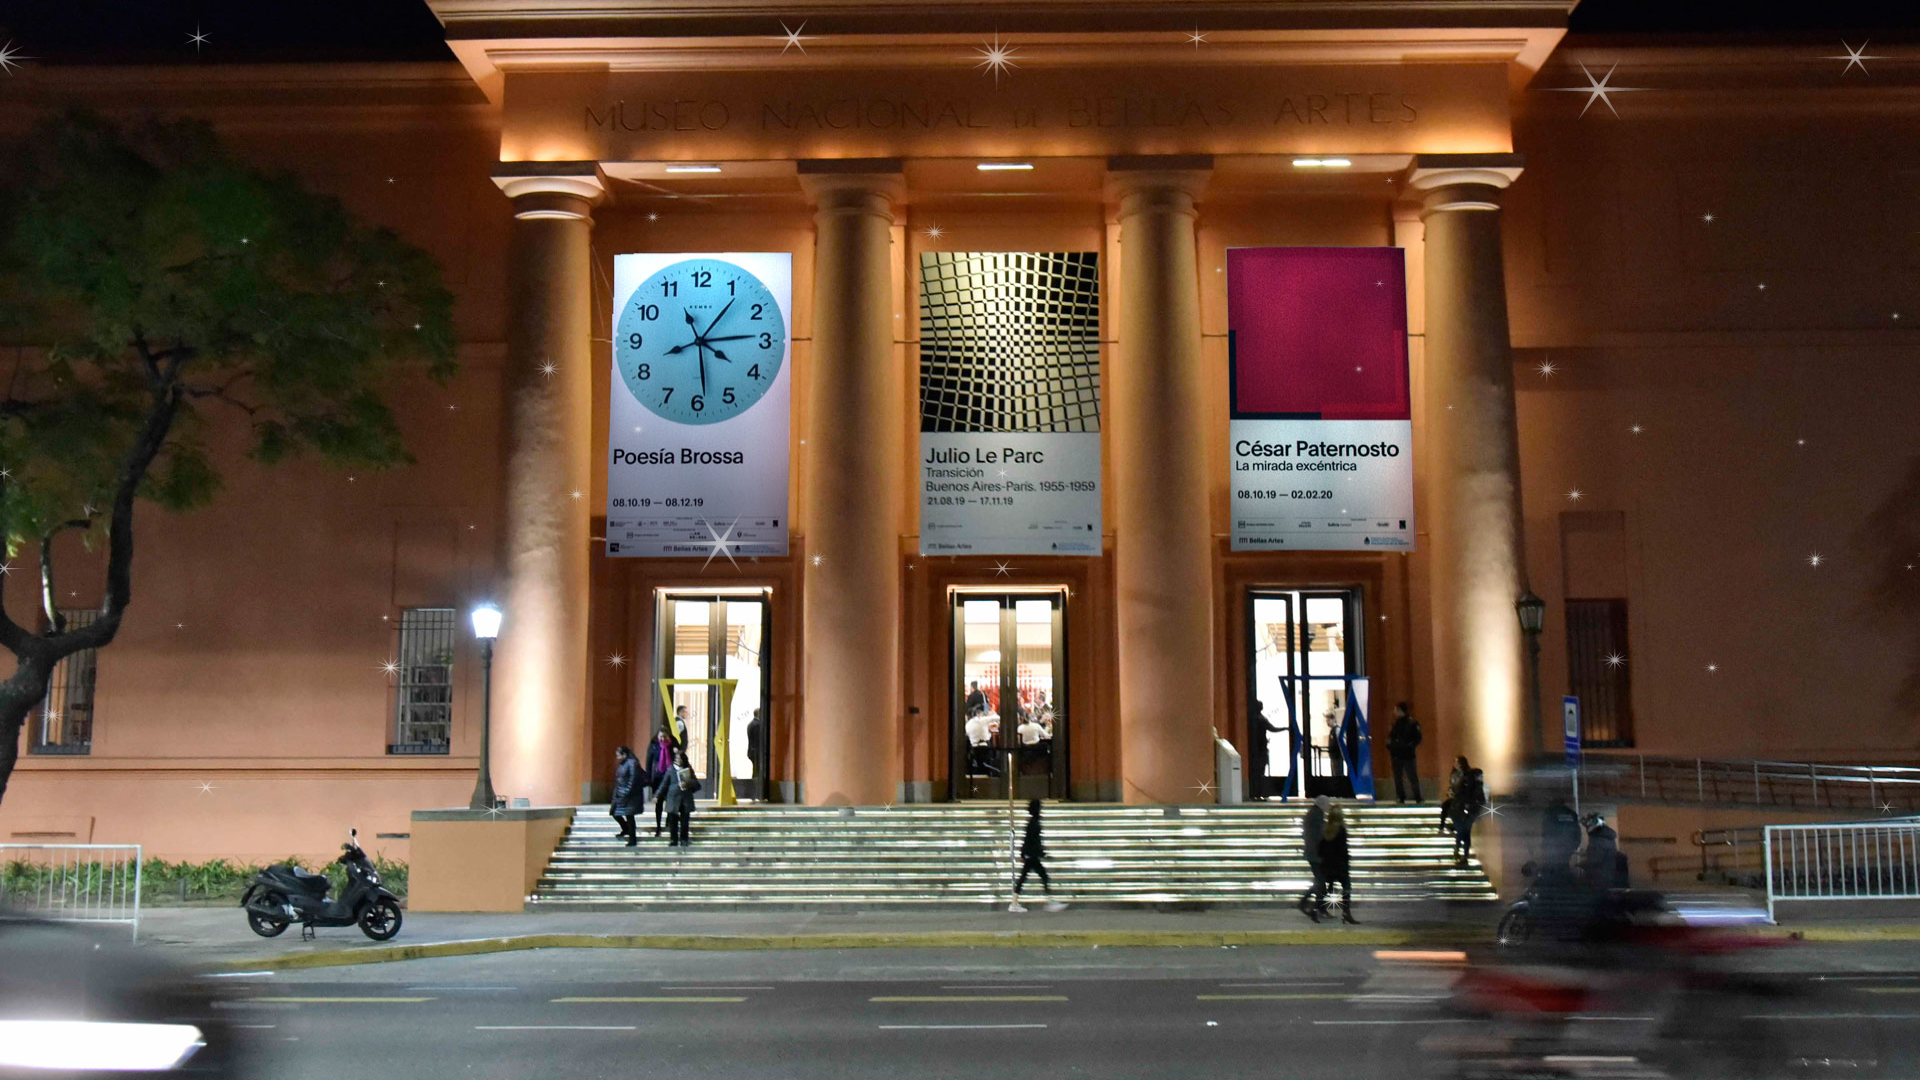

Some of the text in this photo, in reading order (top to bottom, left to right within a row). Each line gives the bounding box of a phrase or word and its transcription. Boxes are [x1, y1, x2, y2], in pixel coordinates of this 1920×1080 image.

[585, 100, 730, 131] MUSEO
[763, 98, 990, 130] NACIONAL
[1069, 95, 1234, 128] BELLAS
[1274, 93, 1417, 125] ARTES
[691, 271, 711, 287] 12
[661, 281, 678, 297] 11
[727, 280, 735, 296] 1
[638, 304, 659, 320] 10
[750, 303, 762, 320] 2
[630, 332, 642, 349] 9
[759, 332, 771, 349] 3
[638, 363, 650, 379] 8
[747, 363, 760, 380] 4
[662, 387, 673, 403] 7
[691, 394, 704, 411] 6
[722, 386, 735, 403] 5
[614, 447, 743, 464] Poesía Brossa
[926, 447, 1044, 463] Julio Le Parc
[1236, 440, 1399, 457] César Paternosto
[926, 466, 983, 477] Transición
[1236, 460, 1357, 471] La mirada excéntrica
[926, 481, 969, 491] Buenos
[613, 498, 650, 507] 08.10.19
[665, 497, 703, 507] 08.12.19
[928, 496, 965, 505] 21.08.19
[981, 496, 1013, 505] 17.11.19
[1238, 490, 1276, 499] 08.10.19
[1292, 490, 1332, 499] 02.02.20
